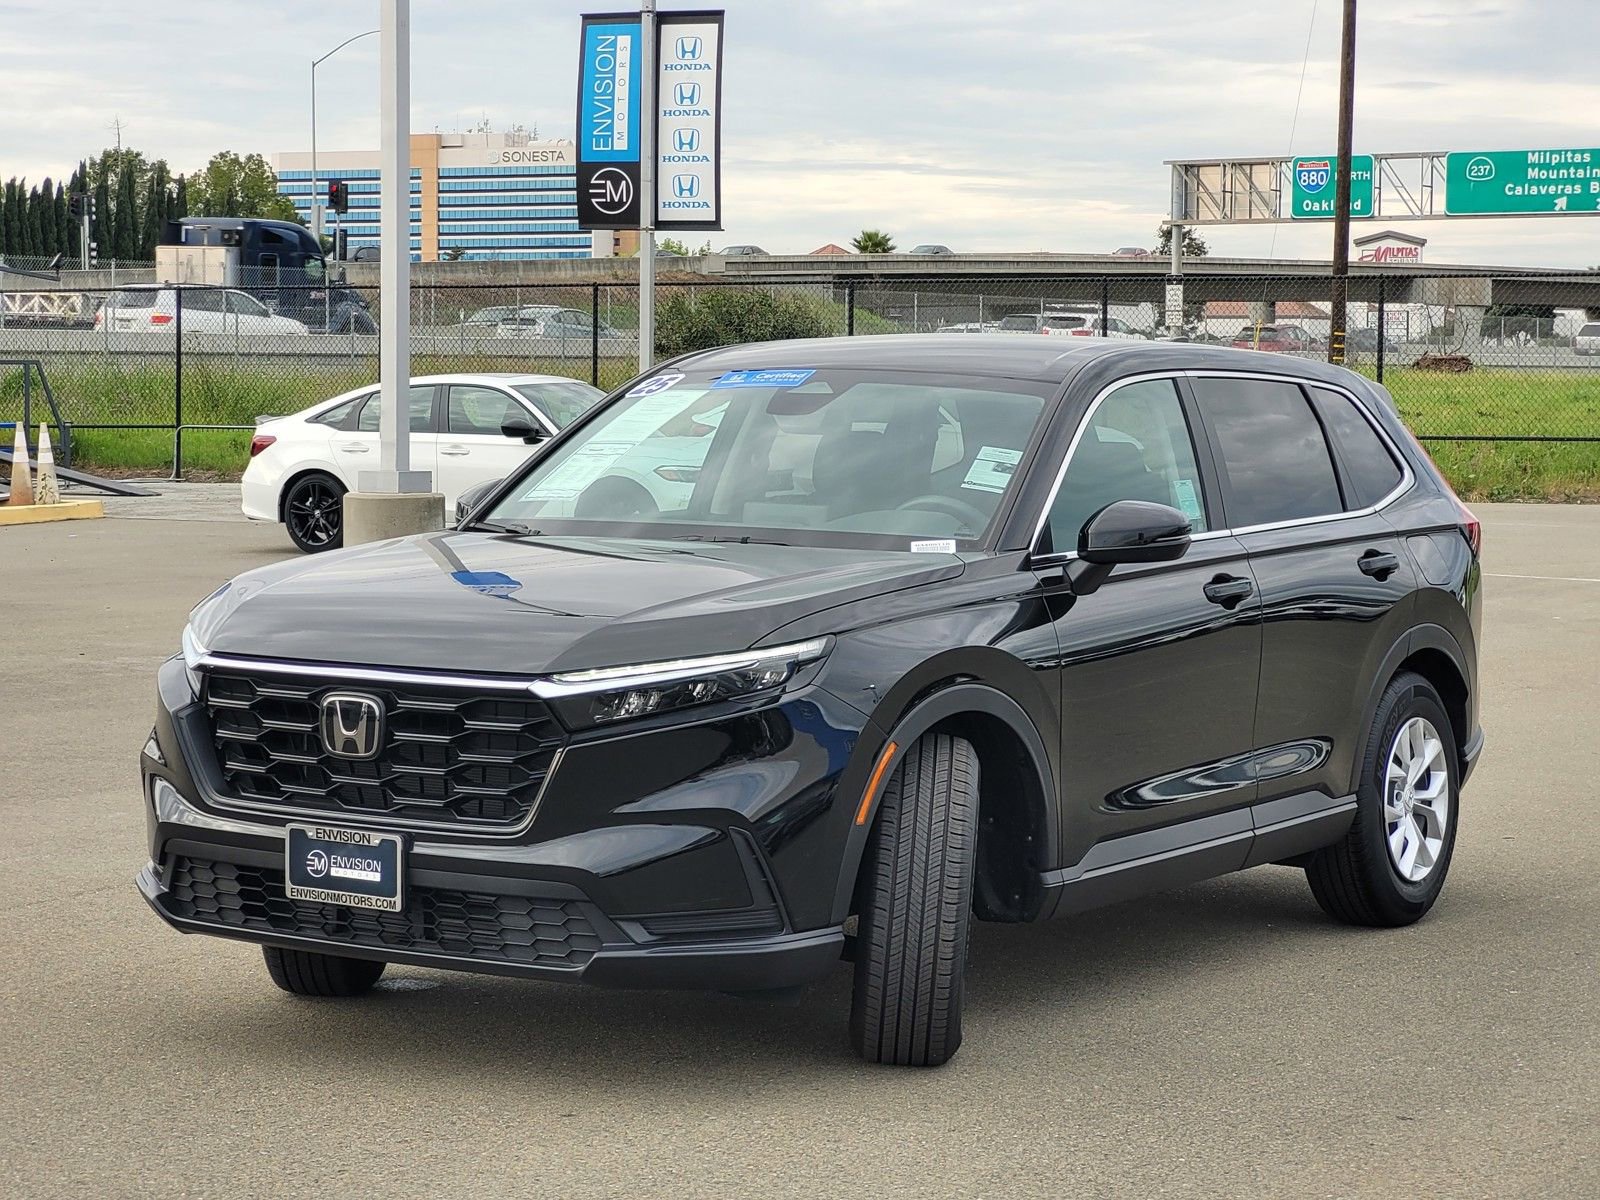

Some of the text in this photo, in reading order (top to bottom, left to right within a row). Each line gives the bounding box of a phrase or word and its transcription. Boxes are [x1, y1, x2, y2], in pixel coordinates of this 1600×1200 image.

[663, 63, 712, 71] HONDA
[592, 35, 616, 151] ENVISION
[617, 46, 628, 141] MOTORS
[663, 109, 711, 117] HONDA
[502, 151, 565, 162] SONESTA
[662, 155, 711, 163] HONDA
[1527, 151, 1591, 166] Milpitas
[1335, 171, 1371, 181] RTH
[1470, 165, 1491, 176] 237
[1527, 166, 1600, 179] Mountain
[1300, 171, 1327, 186] 880
[1504, 183, 1582, 195] Calaveras
[662, 201, 711, 209] HONDA
[1303, 199, 1361, 211] Oakld
[315, 828, 371, 844] ENVISION
[330, 855, 381, 872] ENVISION
[290, 887, 397, 910] ENVISIONMOTORS.COM
